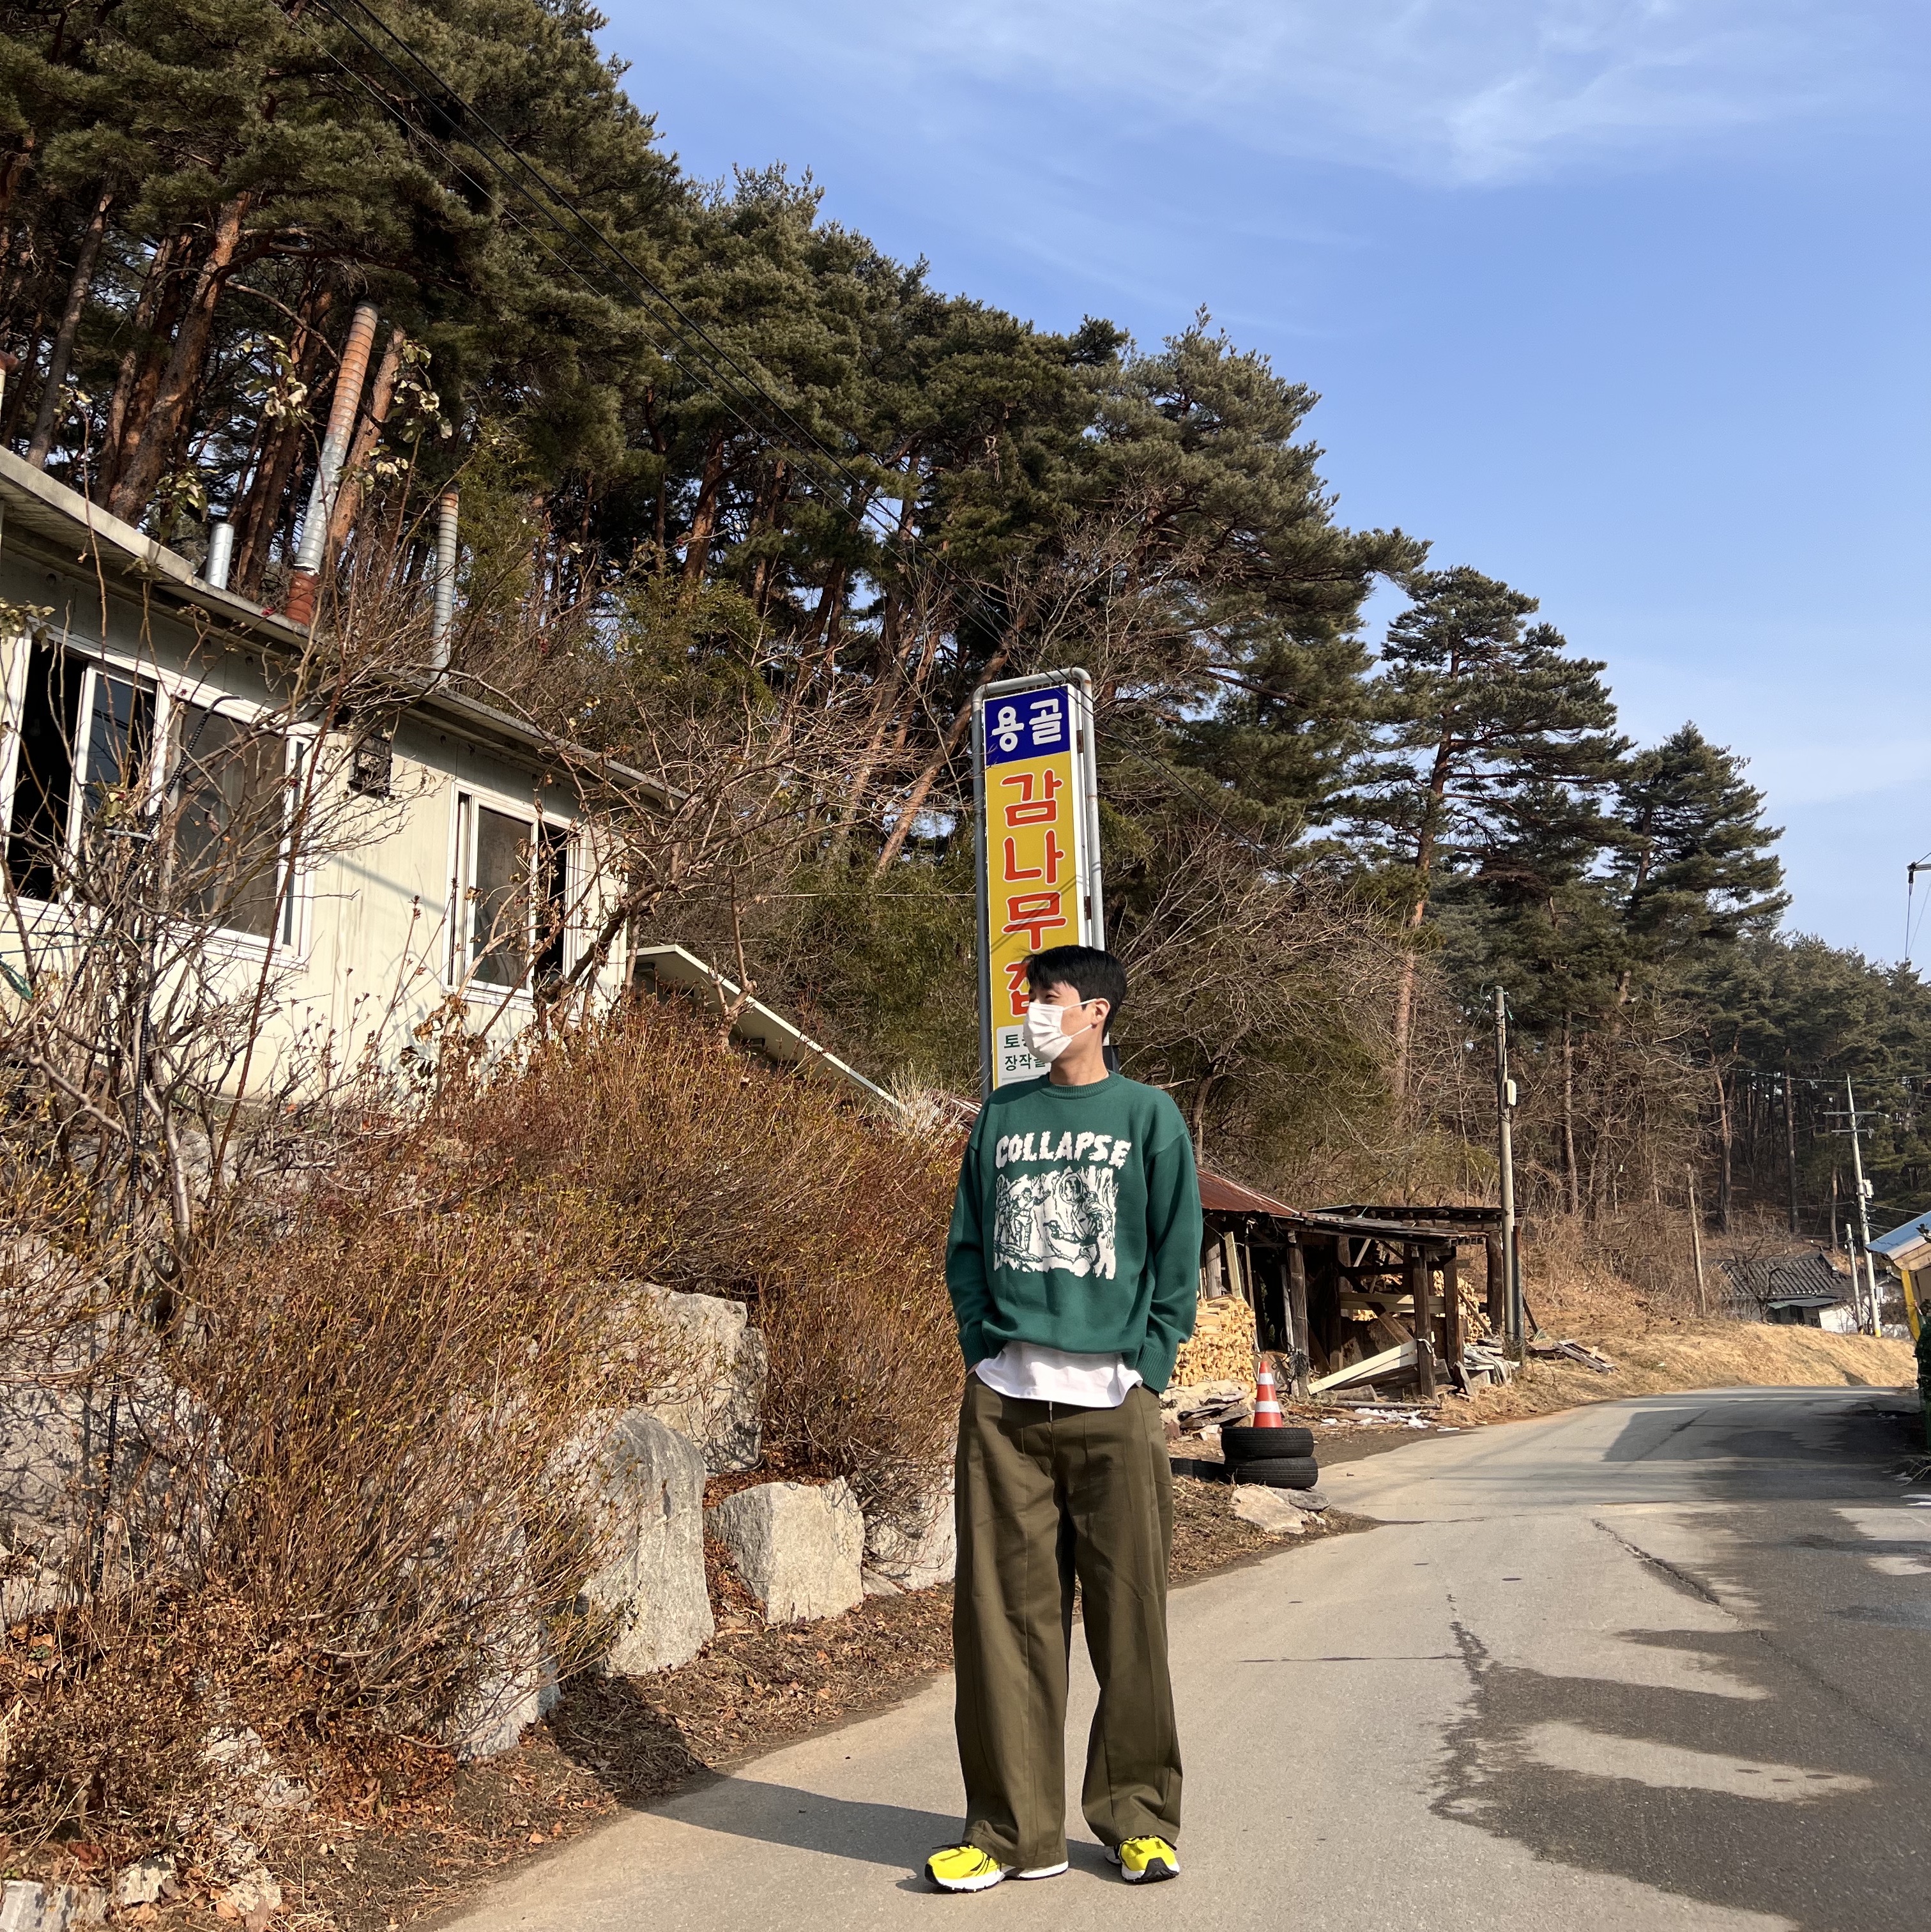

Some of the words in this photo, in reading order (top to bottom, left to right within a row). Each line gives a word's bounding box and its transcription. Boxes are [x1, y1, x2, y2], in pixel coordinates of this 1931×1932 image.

[991, 698, 1062, 752] 용골
[1004, 1034, 1027, 1048] 토
[995, 1130, 1132, 1169] COLLAPSE
